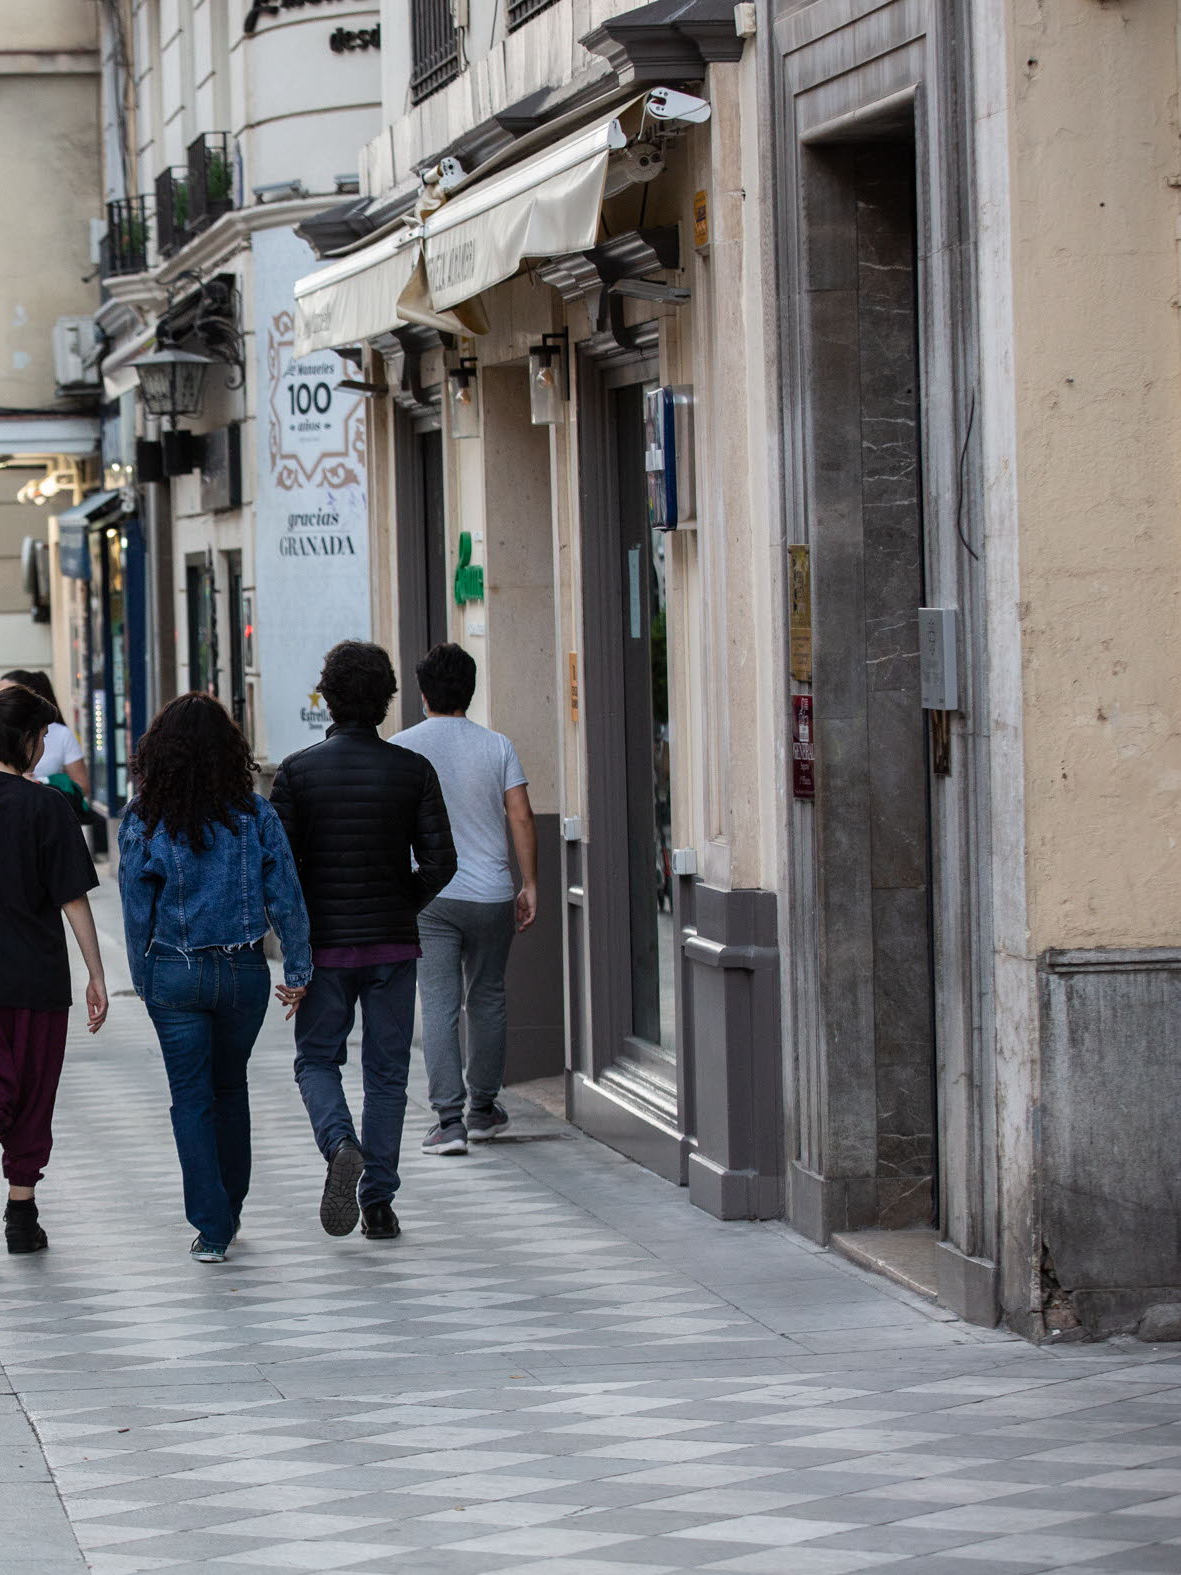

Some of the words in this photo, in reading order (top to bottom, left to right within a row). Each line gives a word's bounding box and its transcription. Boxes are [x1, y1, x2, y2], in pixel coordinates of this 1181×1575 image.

[288, 382, 332, 416] 100
[298, 418, 321, 432] años
[287, 507, 339, 532] gracias
[279, 535, 355, 557] GRANADA
